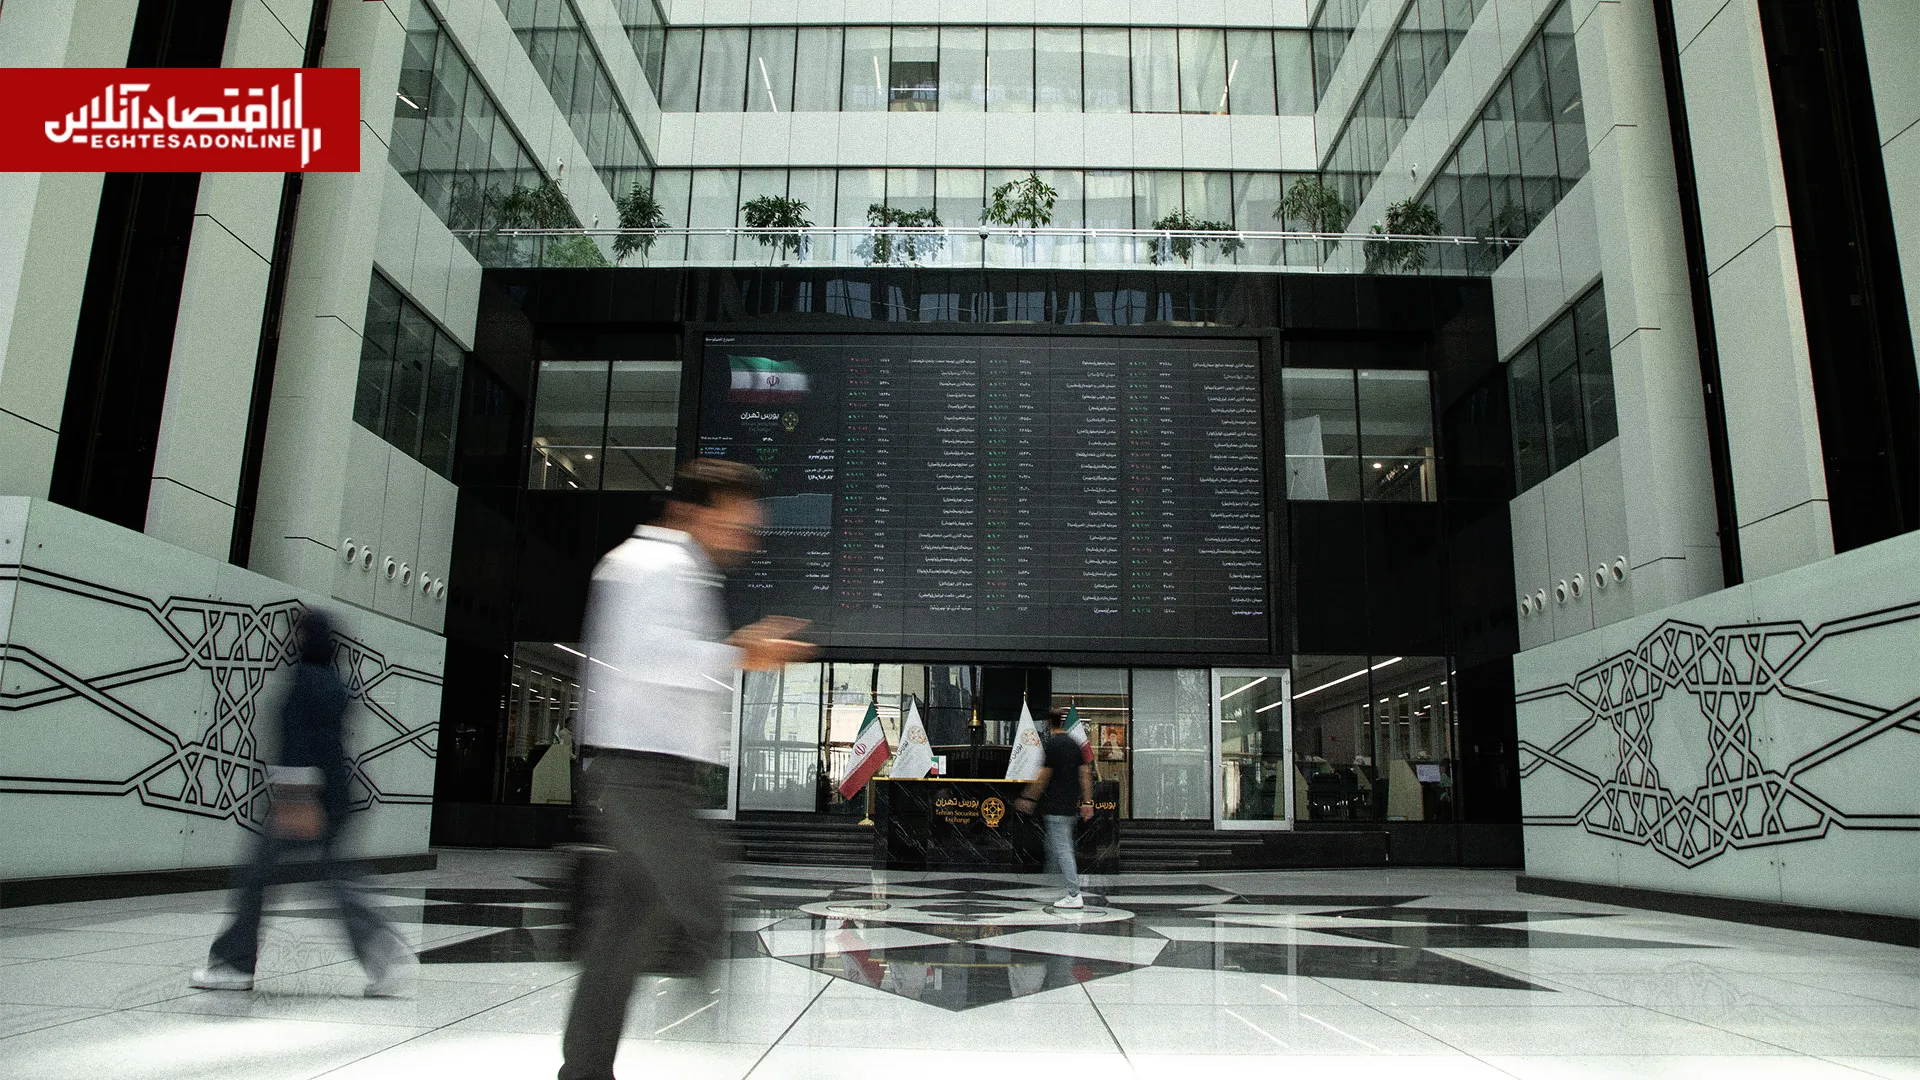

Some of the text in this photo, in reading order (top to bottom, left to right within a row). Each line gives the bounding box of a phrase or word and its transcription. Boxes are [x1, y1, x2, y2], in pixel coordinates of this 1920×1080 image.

[740, 411, 760, 420] تهران
[935, 798, 979, 808] بورس تهران
[1095, 801, 1116, 810] بورس
[954, 809, 979, 817] Securities
[945, 816, 971, 824] Exchange
